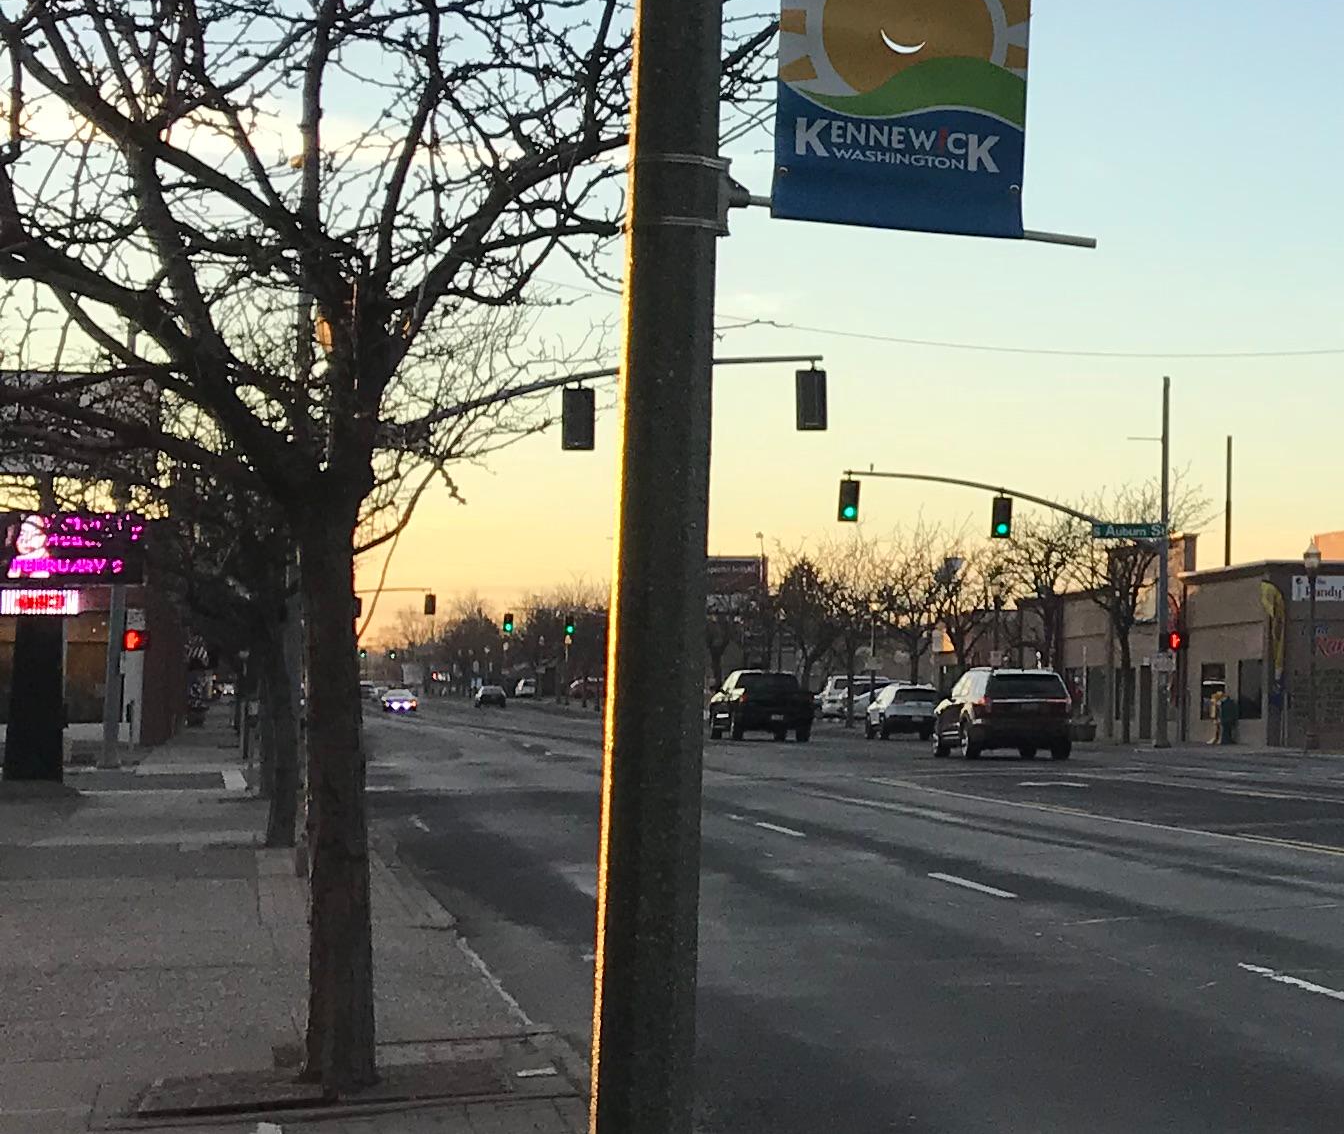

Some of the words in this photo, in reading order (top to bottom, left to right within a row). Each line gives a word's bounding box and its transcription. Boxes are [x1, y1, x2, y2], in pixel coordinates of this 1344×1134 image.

[795, 116, 1000, 173] KENNEWICK
[832, 146, 965, 170] WASHINGTON
[1105, 525, 1147, 537] Auburn
[1151, 524, 1166, 537] St
